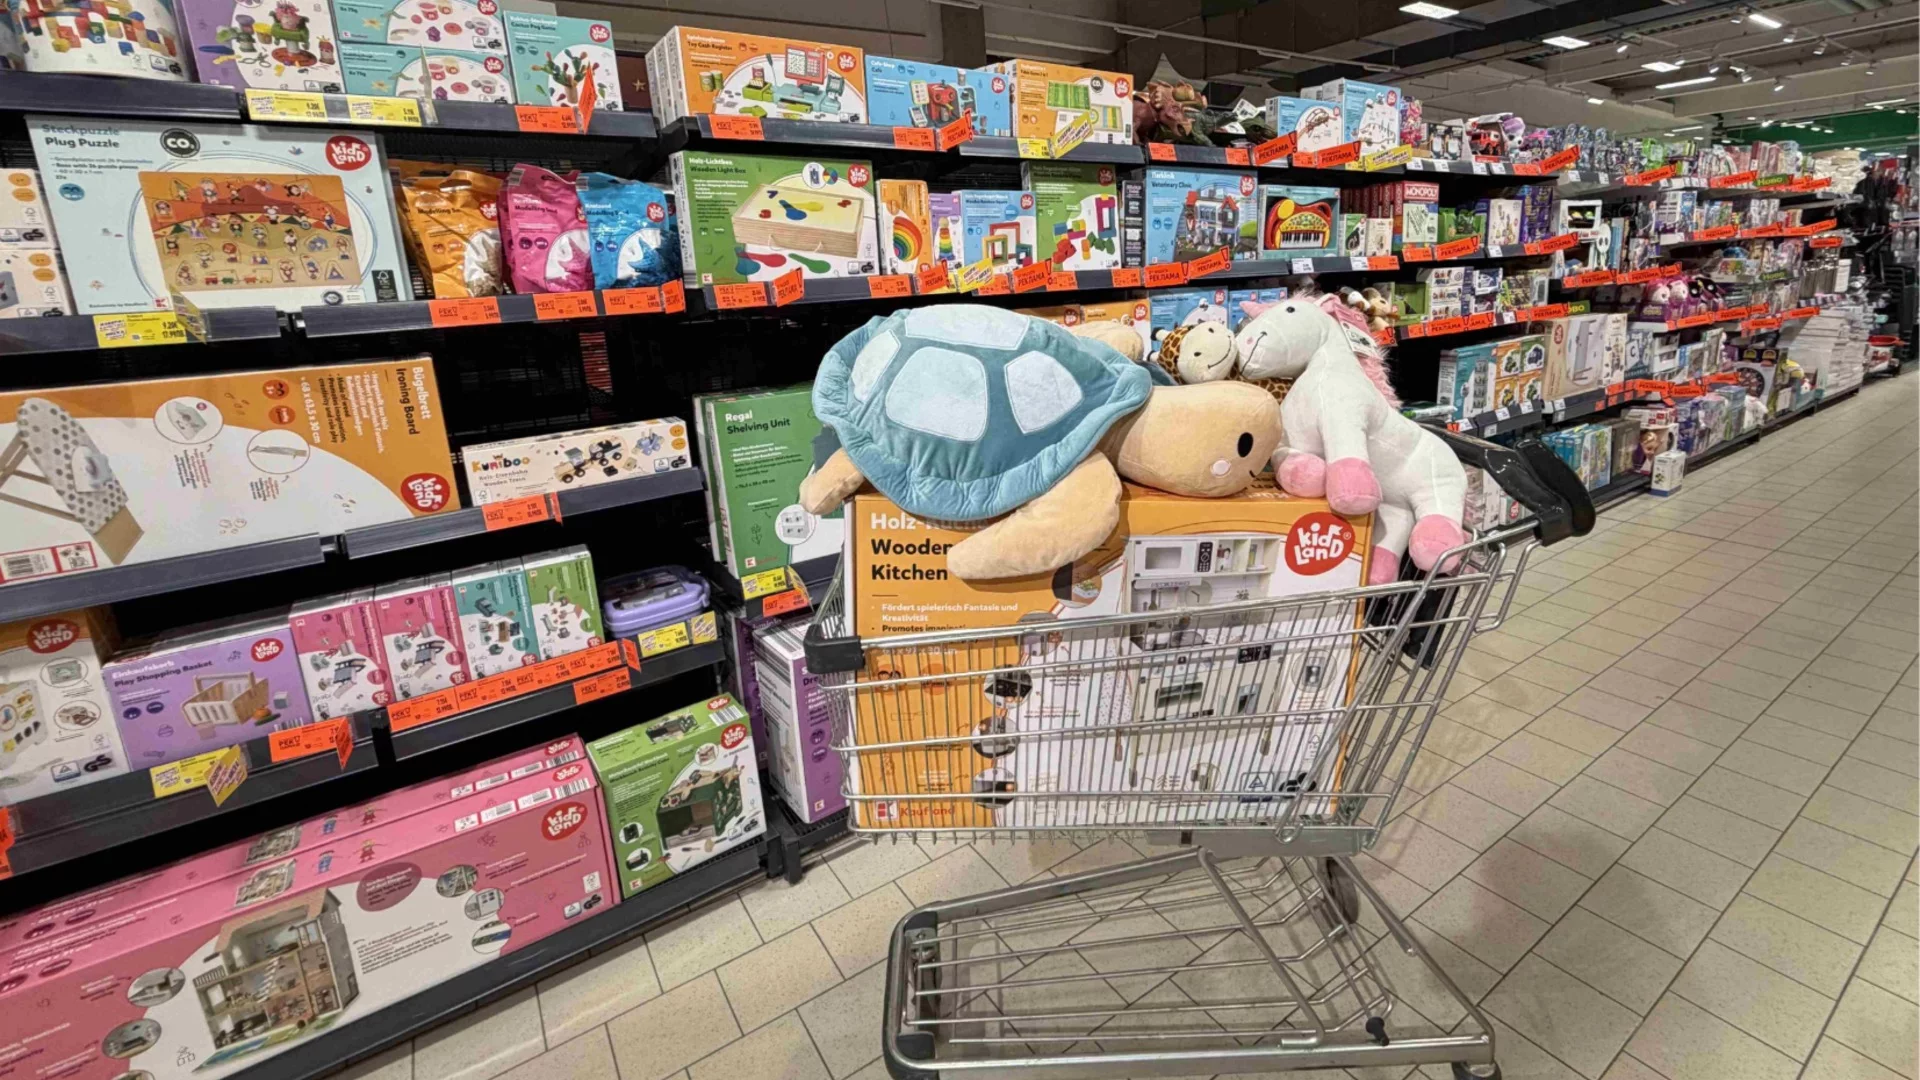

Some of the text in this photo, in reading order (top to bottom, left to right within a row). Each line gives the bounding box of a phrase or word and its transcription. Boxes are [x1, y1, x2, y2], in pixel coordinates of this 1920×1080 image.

[687, 41, 697, 49] Toy
[711, 43, 733, 51] Register
[41, 124, 120, 137] Steckpuzzle
[45, 137, 120, 149] Plug Puzzle
[1258, 143, 1290, 160] РЕКЛАМА
[1321, 151, 1353, 164] РЕКЛАМА
[1151, 182, 1178, 190] Veterinary
[1404, 187, 1438, 198] MONOPOLY
[514, 205, 542, 214] Modelling
[1017, 271, 1046, 287] РЕКЛАМА
[1149, 271, 1180, 282] РЕКЛАМА
[328, 377, 339, 406] Promotes
[412, 366, 432, 420] Bügelbrett
[396, 368, 421, 435] Ironing Board
[725, 409, 753, 423] Regal
[727, 418, 791, 435] Shelving Unit
[483, 476, 526, 488] Wooden Train
[1297, 522, 1344, 548] kid
[871, 564, 948, 581] Kitchen
[881, 603, 1018, 613] Fördert spielerisch Fantasie und
[882, 614, 929, 622] Kreativität
[882, 624, 924, 632] Promotes
[114, 660, 213, 688] Play Shopping Basket
[901, 806, 955, 817] Kaufand
